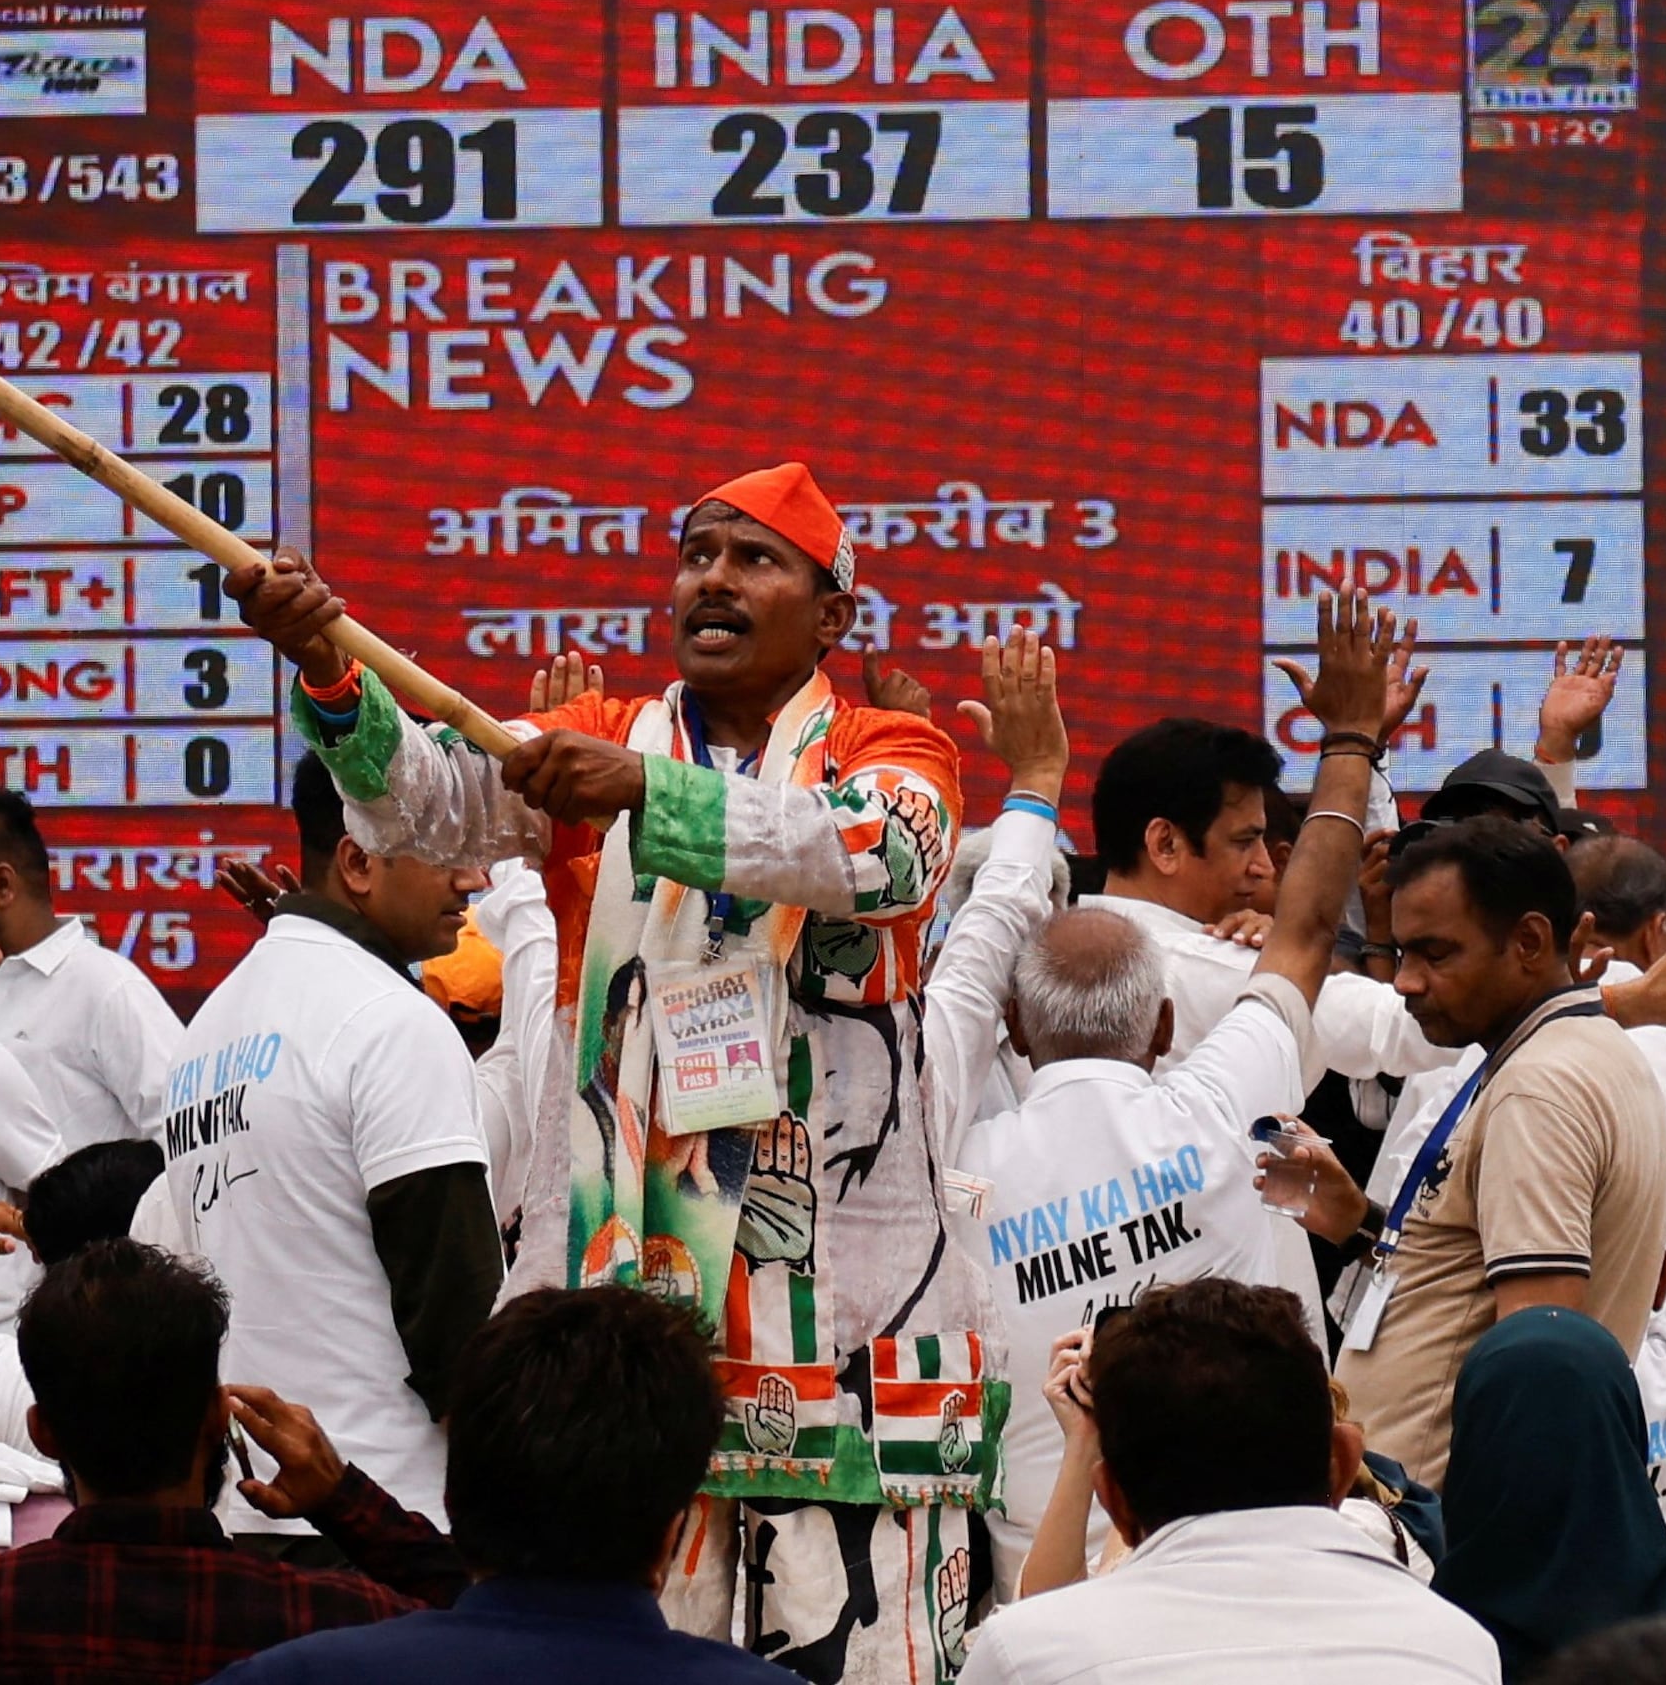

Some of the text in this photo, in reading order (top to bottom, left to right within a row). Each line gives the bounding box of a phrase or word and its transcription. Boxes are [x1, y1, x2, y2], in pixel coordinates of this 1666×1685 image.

[53, 3, 147, 23] Partner
[269, 17, 526, 95] NDA
[653, 6, 995, 89] INDIA
[710, 111, 942, 217] 237
[1173, 105, 1325, 209] 15
[1501, 119, 1613, 146] 11:29
[290, 119, 518, 225] 291
[104, 261, 252, 303] बंगाल
[325, 250, 889, 324] BREAKING
[1351, 230, 1528, 291] बिहार
[327, 326, 694, 412] NEWS
[158, 383, 250, 444] 28
[1274, 389, 1626, 457] NDA 33
[425, 486, 648, 556] अमित
[835, 480, 1054, 549] करीब
[1276, 538, 1596, 604] INDIA 7
[460, 606, 652, 657] लाख
[919, 580, 1082, 651] आगे
[184, 649, 230, 710] 3
[1275, 703, 1438, 754] OH
[185, 737, 230, 798] 0
[663, 972, 746, 1006] BHARAT
[672, 1014, 739, 1040] YATRA
[683, 1071, 713, 1089] PASS
[988, 1143, 1206, 1267] NYAY KA HAQ
[1014, 1231, 1117, 1305] MILNE
[1119, 1201, 1202, 1266] TAK.
